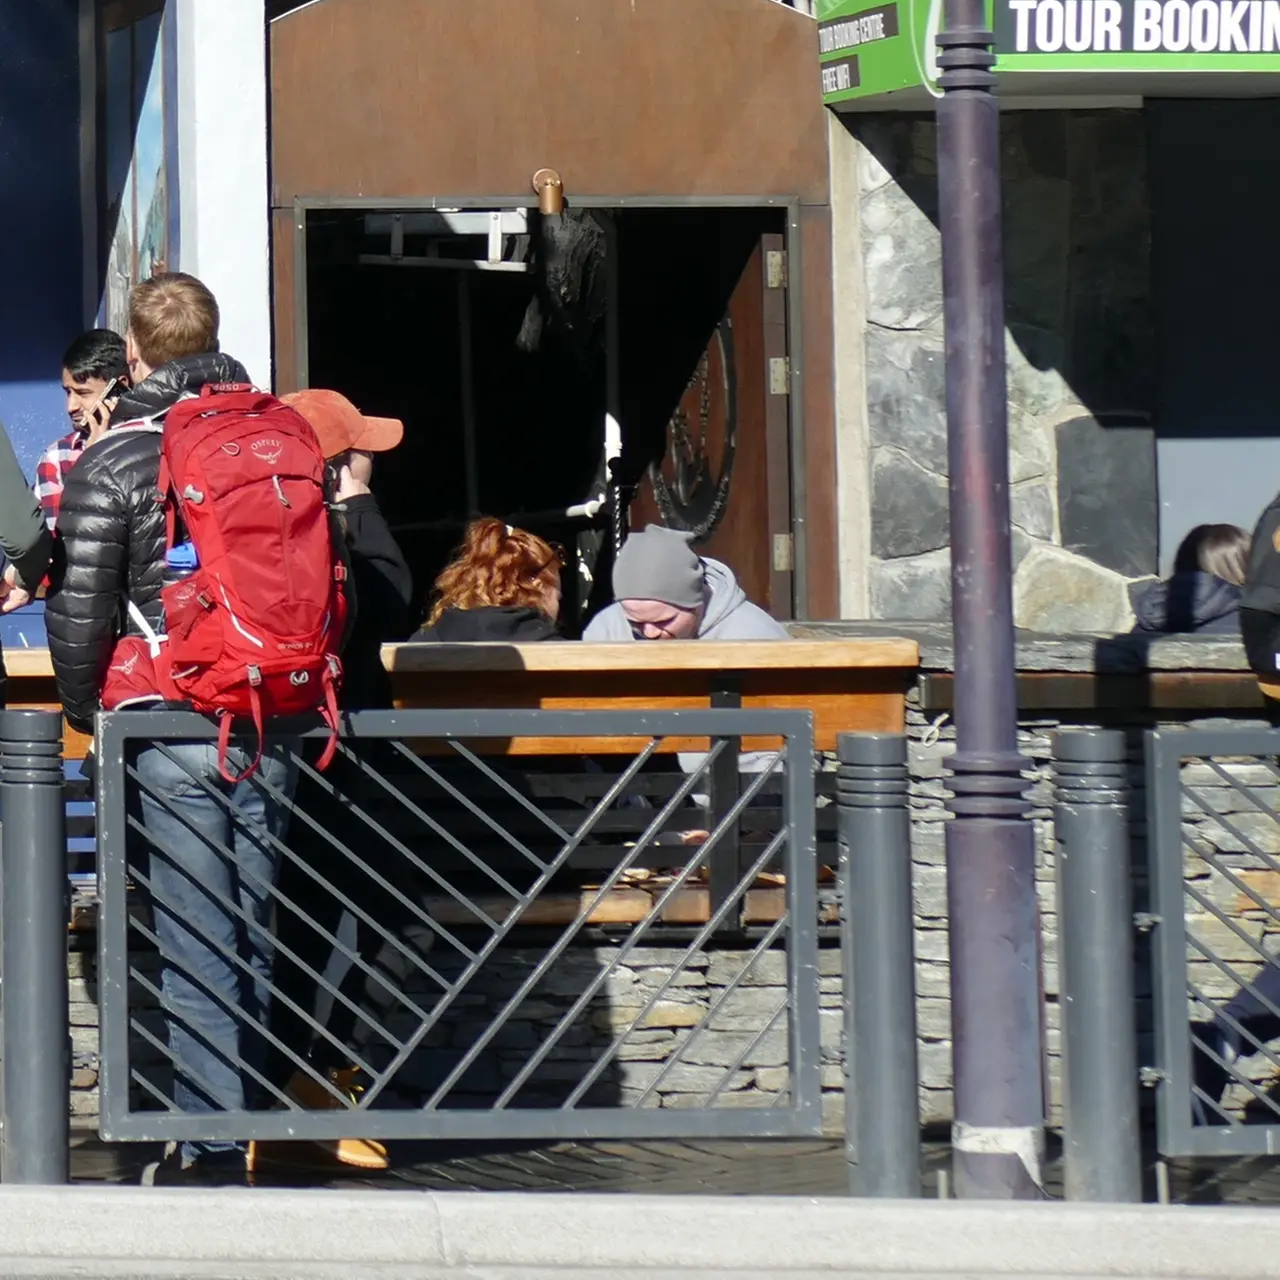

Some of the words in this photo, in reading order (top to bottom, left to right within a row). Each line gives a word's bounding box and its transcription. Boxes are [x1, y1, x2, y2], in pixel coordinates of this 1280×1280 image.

[833, 20, 860, 49] BOOKING
[860, 14, 885, 42] CENTRE
[823, 67, 837, 93] FREE
